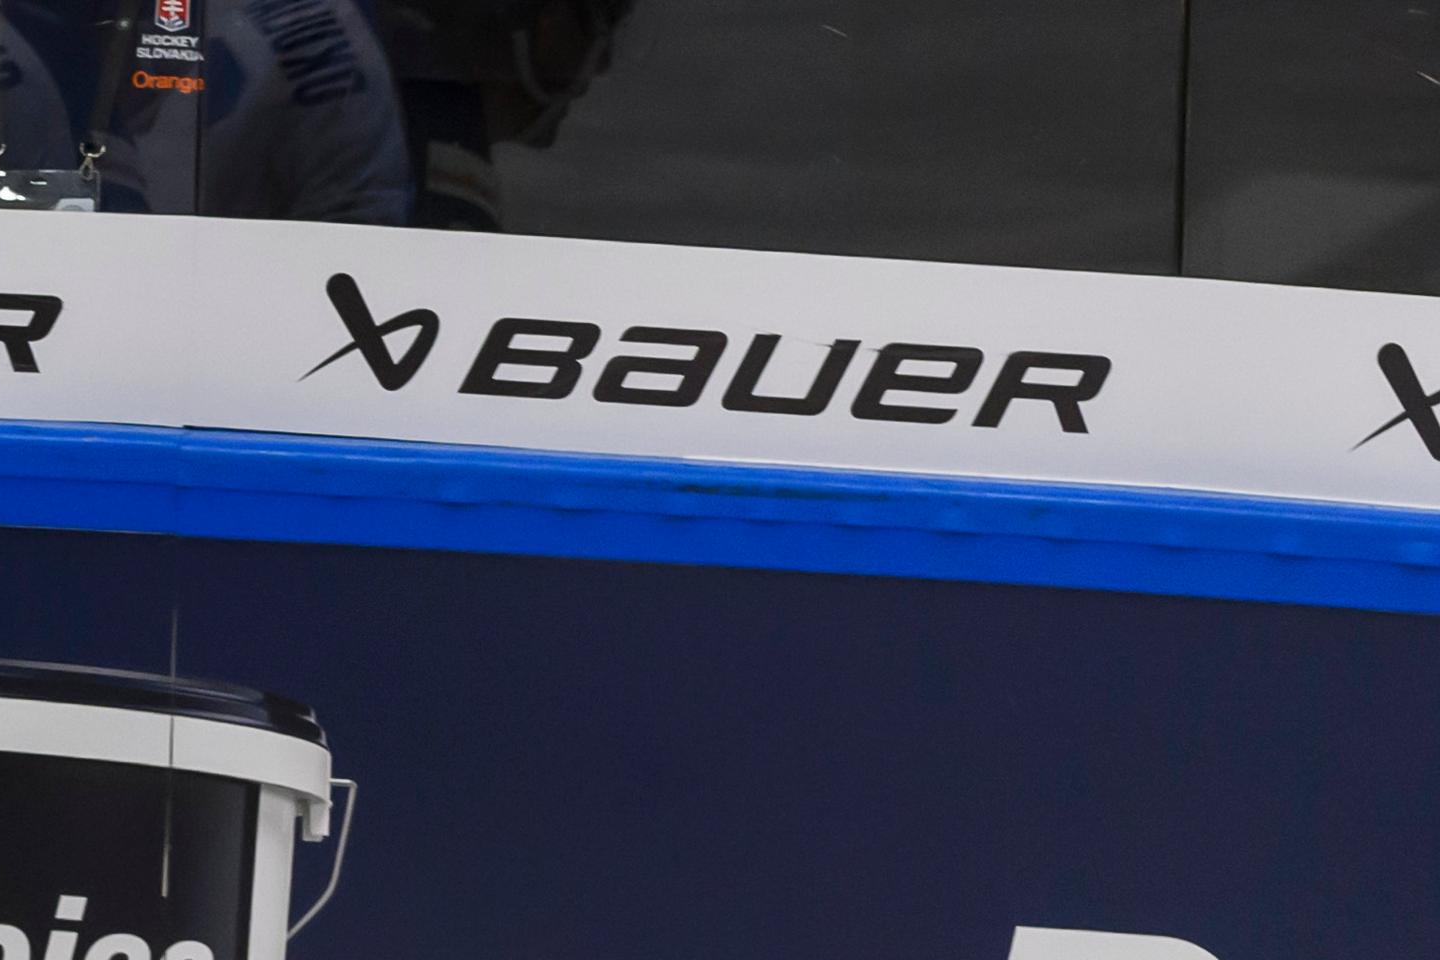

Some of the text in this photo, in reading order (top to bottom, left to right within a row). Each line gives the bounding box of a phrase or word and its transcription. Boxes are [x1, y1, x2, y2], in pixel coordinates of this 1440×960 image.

[141, 34, 200, 48] HOCKEY
[132, 70, 205, 94] Orange
[458, 317, 1113, 434] BAUER
